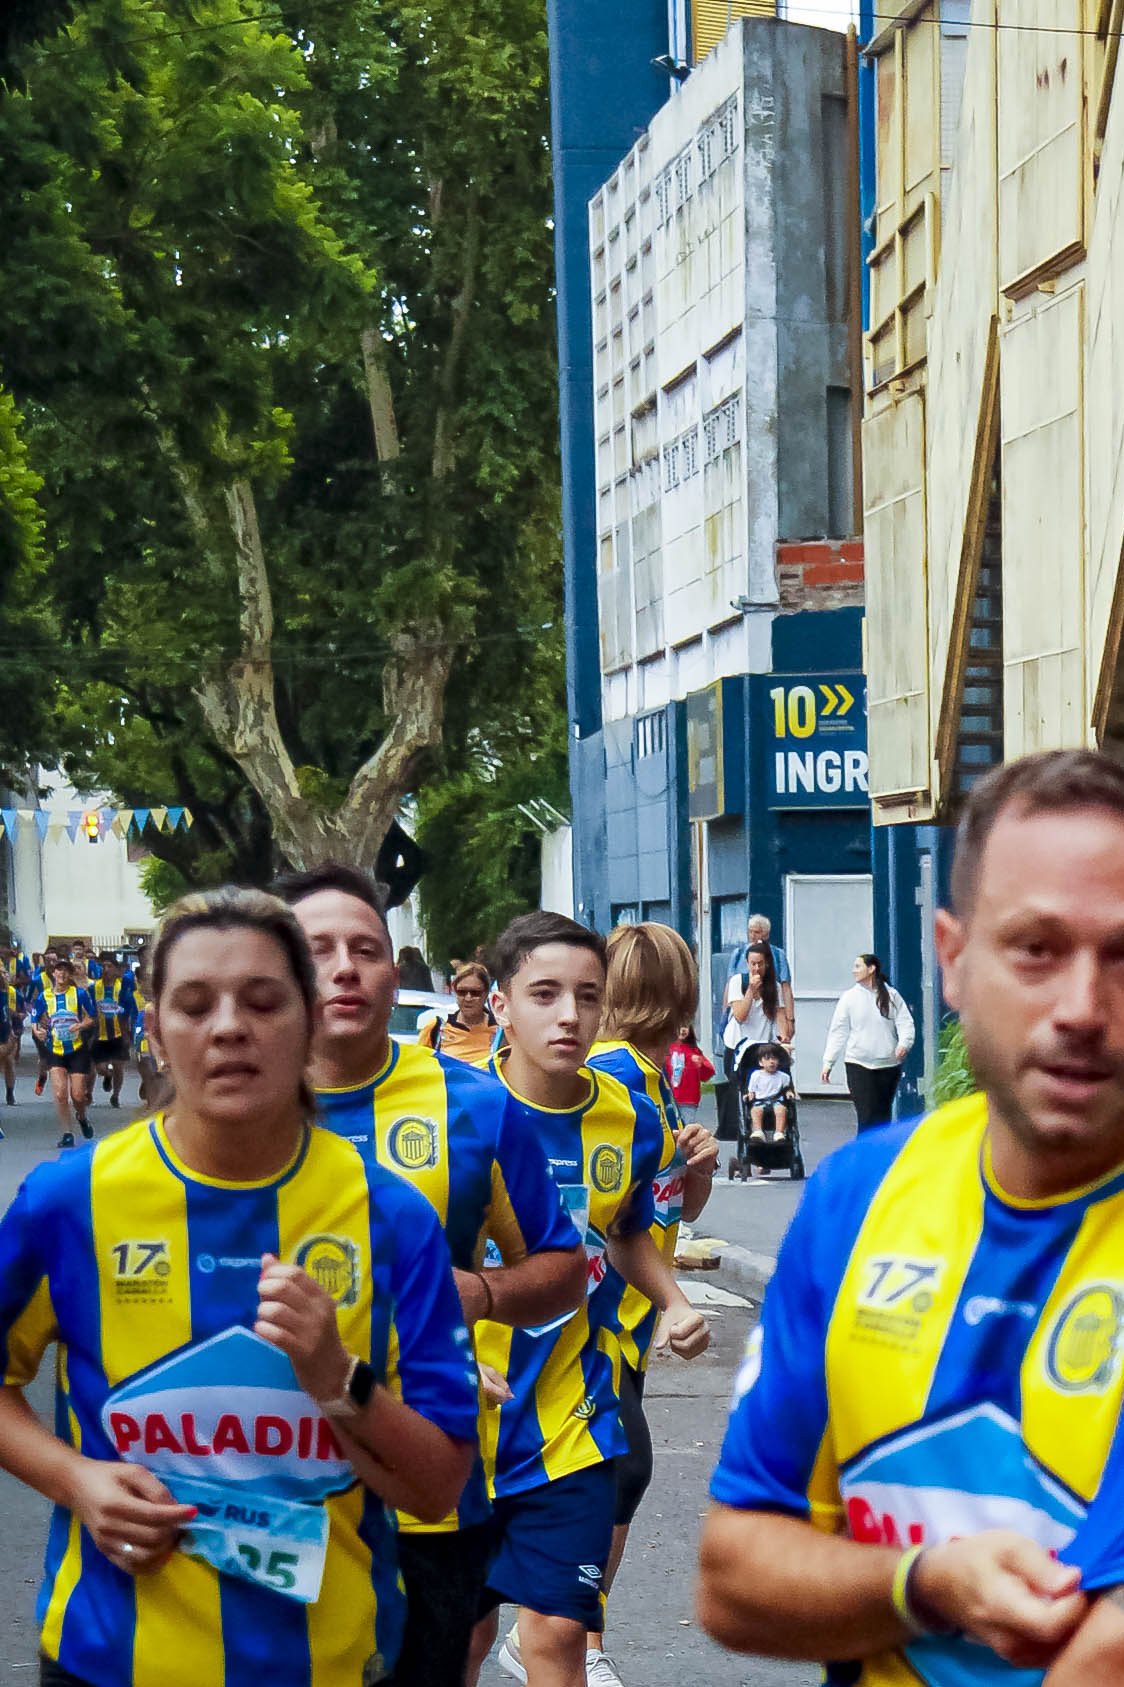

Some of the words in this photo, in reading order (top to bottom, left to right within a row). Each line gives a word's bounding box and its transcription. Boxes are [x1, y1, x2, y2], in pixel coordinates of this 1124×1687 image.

[769, 685, 817, 739] 10
[774, 750, 869, 794] INGR
[111, 1242, 166, 1275] 17
[872, 1260, 937, 1302] 17
[224, 1504, 271, 1528] RUS
